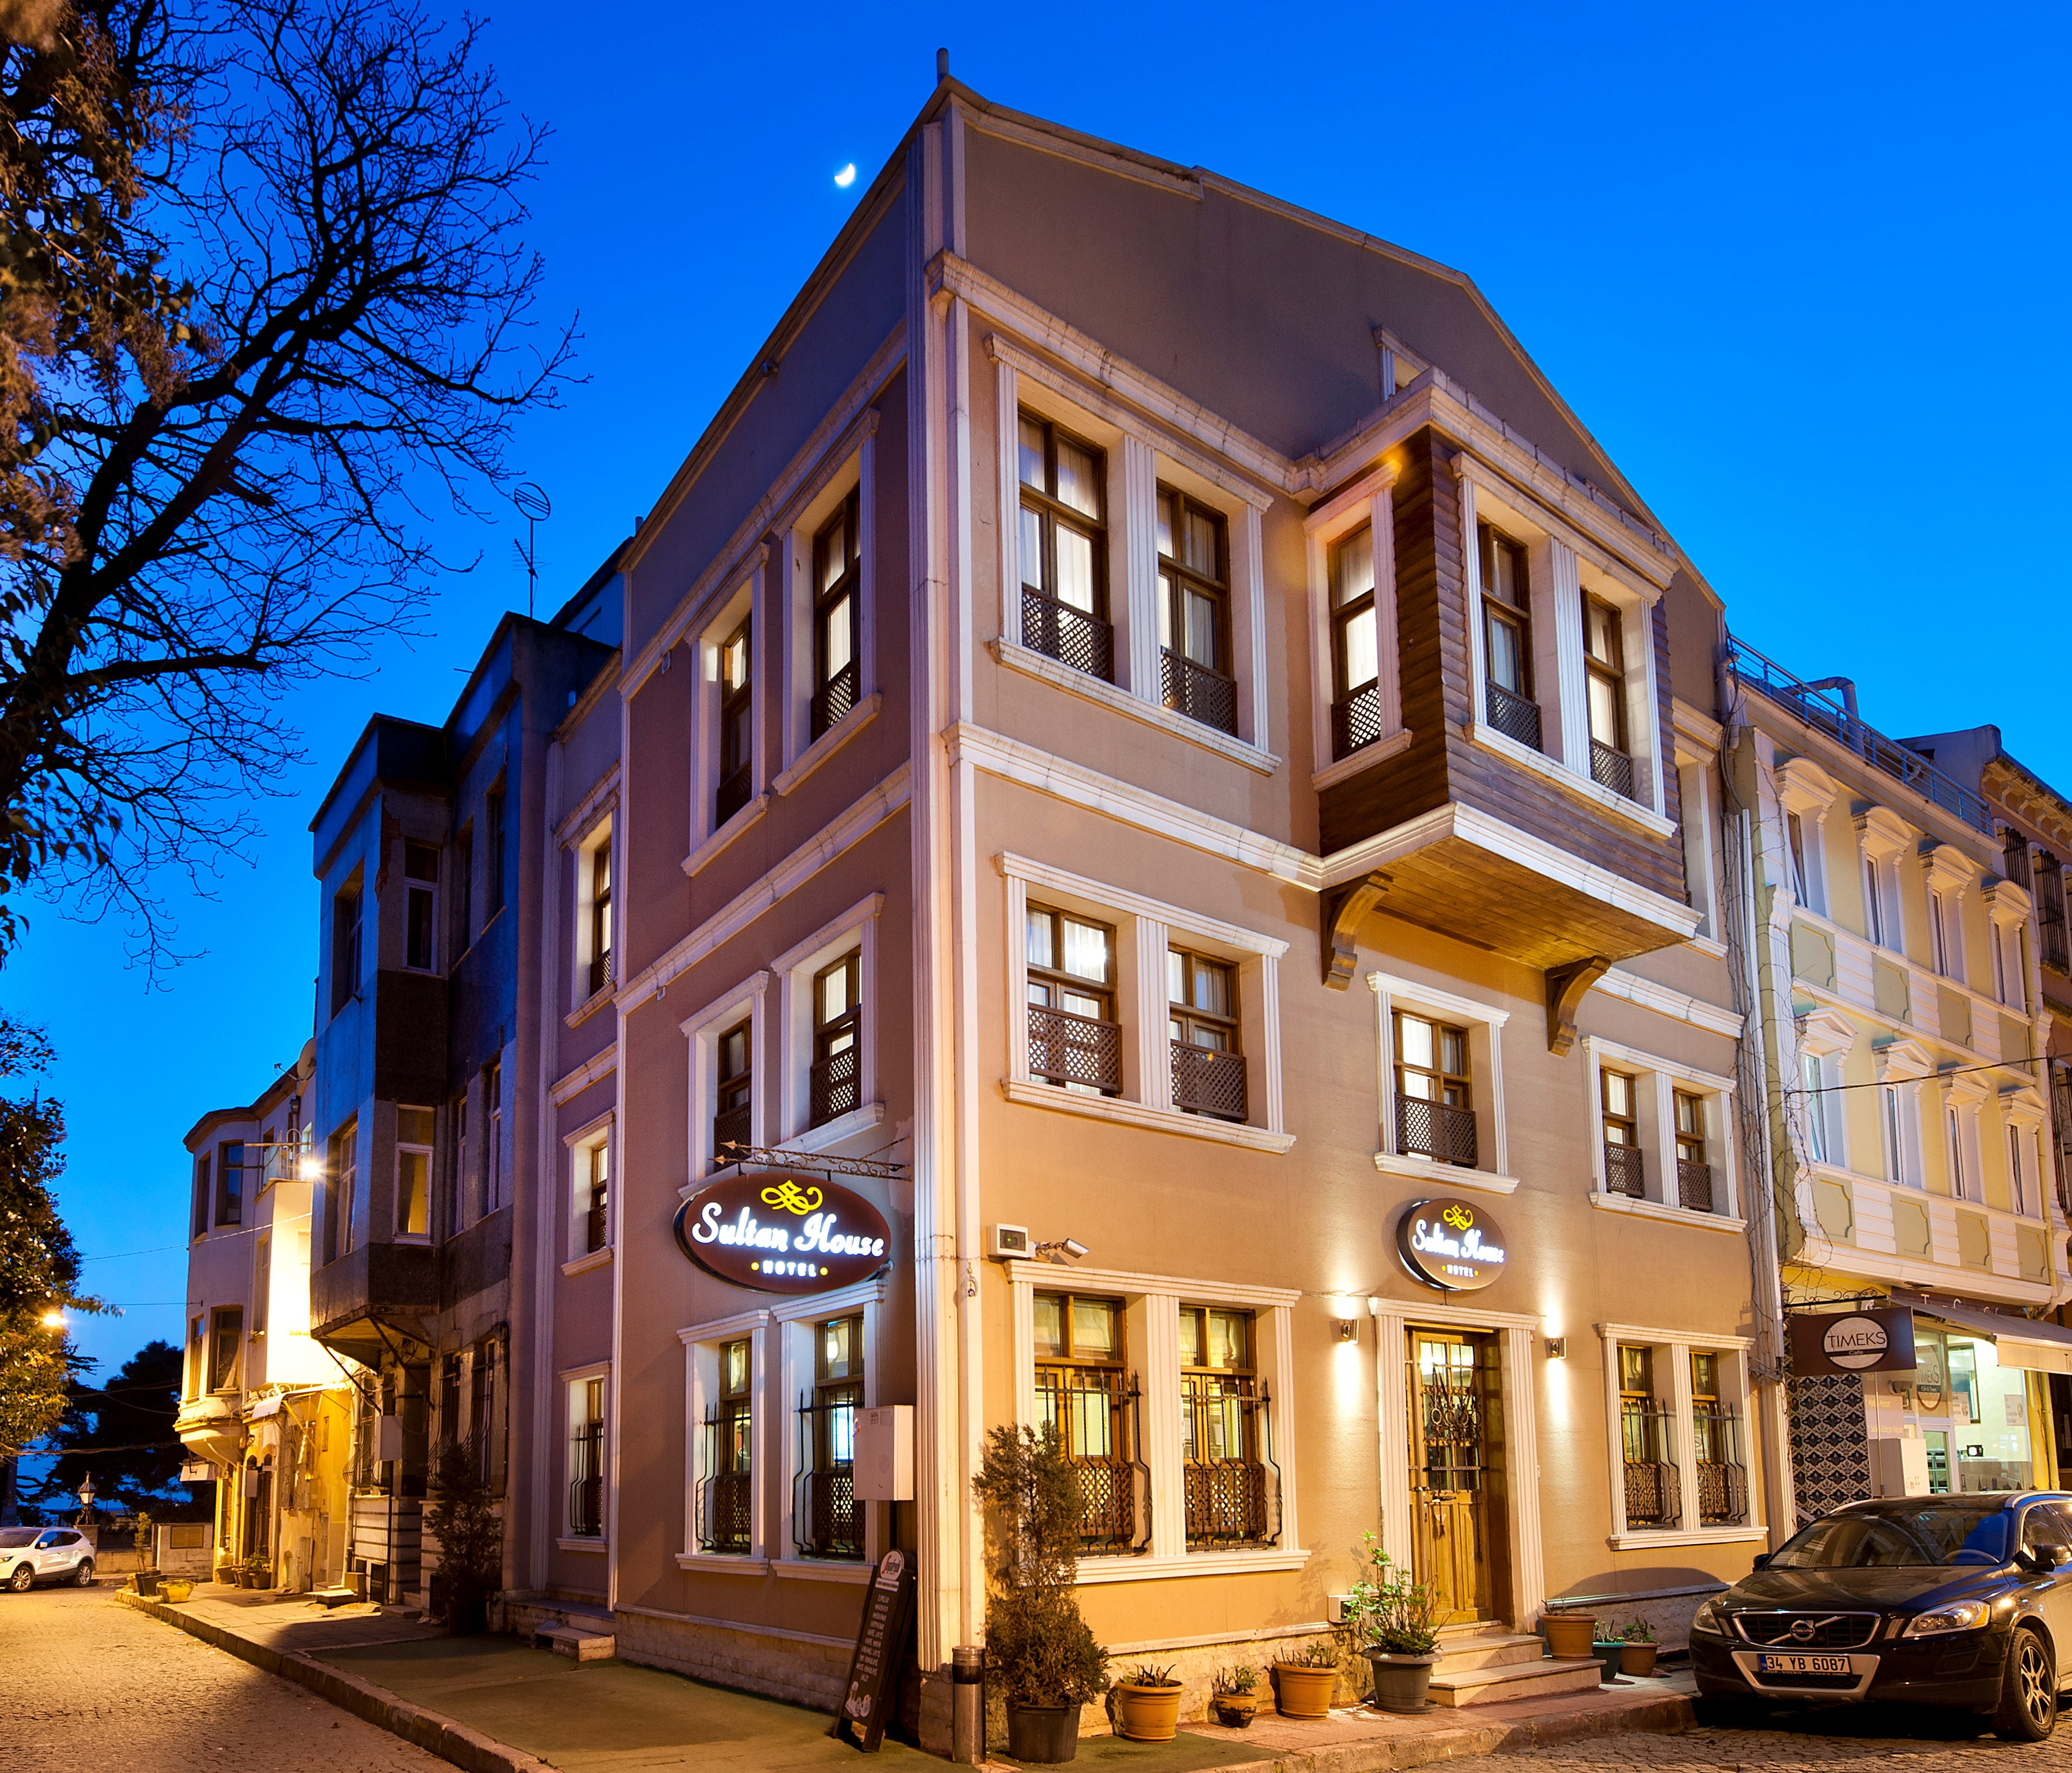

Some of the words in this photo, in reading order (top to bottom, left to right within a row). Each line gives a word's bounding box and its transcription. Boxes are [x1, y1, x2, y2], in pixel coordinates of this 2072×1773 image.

[691, 1202, 789, 1252] Sultan
[793, 1212, 885, 1257] House
[1412, 1219, 1460, 1258] Sultan
[1460, 1228, 1505, 1263] House
[762, 1260, 817, 1277] HOTEL
[1446, 1264, 1475, 1278] HOTEL
[1826, 1331, 1886, 1348] TIMEKS
[1767, 1656, 1783, 1670] 34
[1789, 1657, 1806, 1670] YB
[1812, 1658, 1846, 1671] 6087
